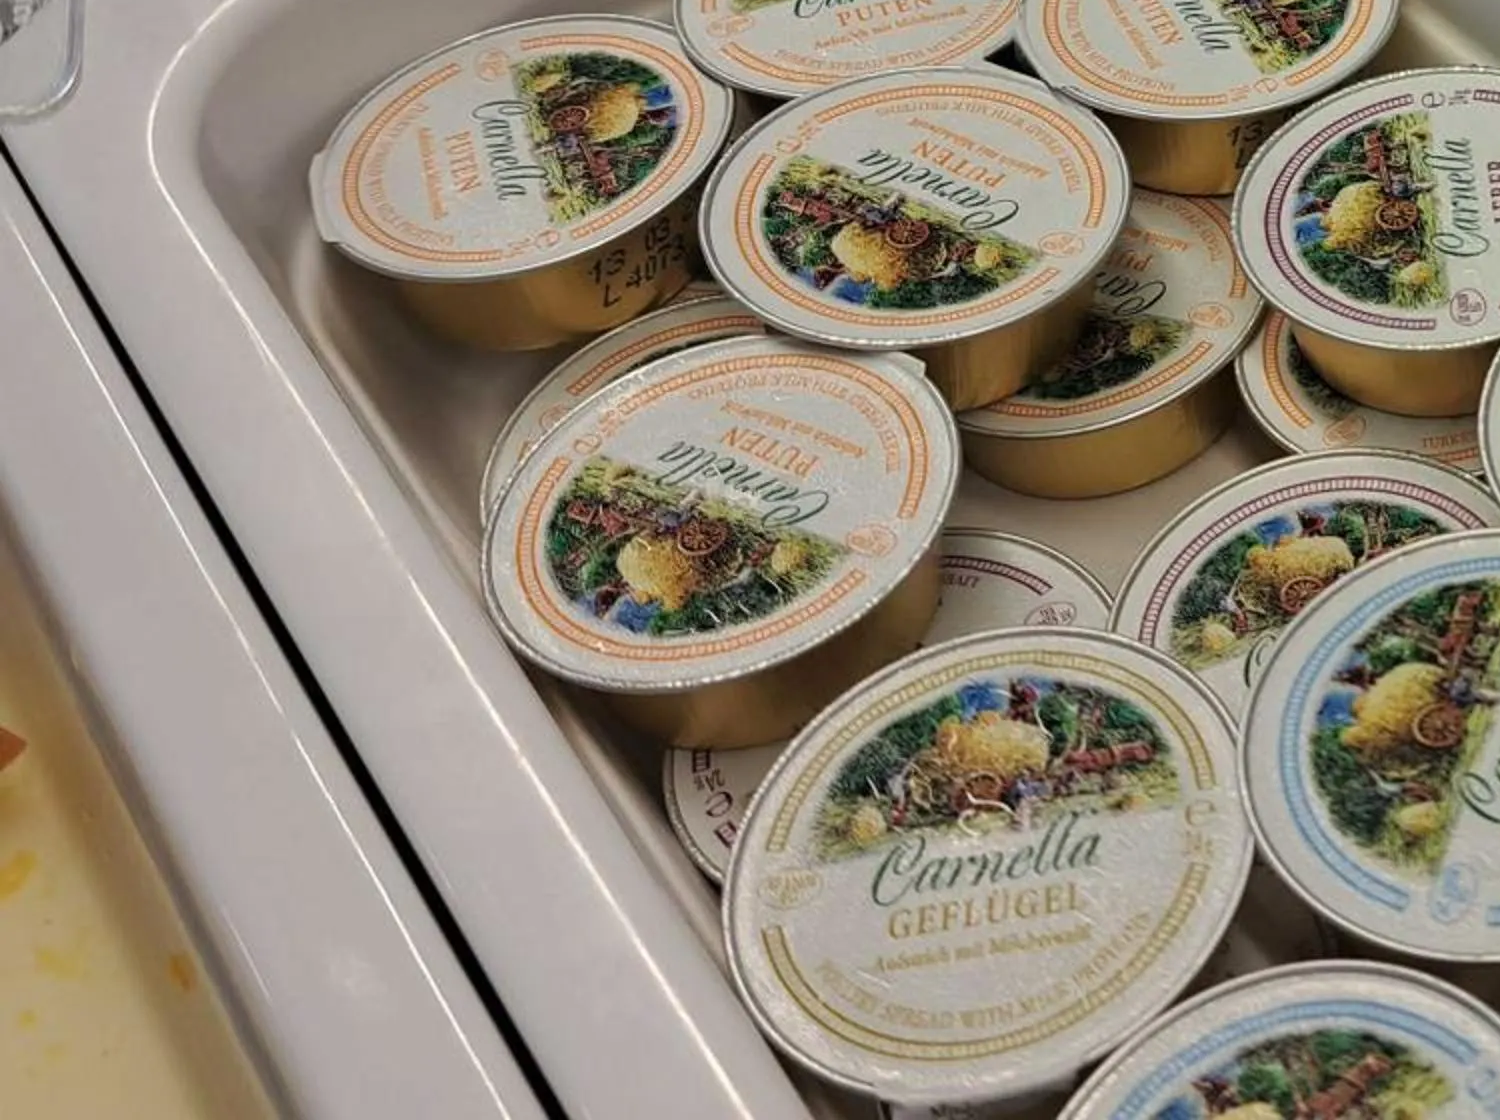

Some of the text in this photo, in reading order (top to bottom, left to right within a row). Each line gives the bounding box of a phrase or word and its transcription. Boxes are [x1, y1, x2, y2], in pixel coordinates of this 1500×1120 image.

[471, 99, 548, 201] Carnella
[855, 149, 1016, 231] Carnella
[909, 138, 1006, 188] PUTEN
[1423, 137, 1489, 256] Carnella
[654, 439, 826, 531] Carnella
[717, 424, 820, 477] PUTEN
[872, 808, 1100, 907] Carnella
[888, 878, 1084, 940] GEFLÜGEL
